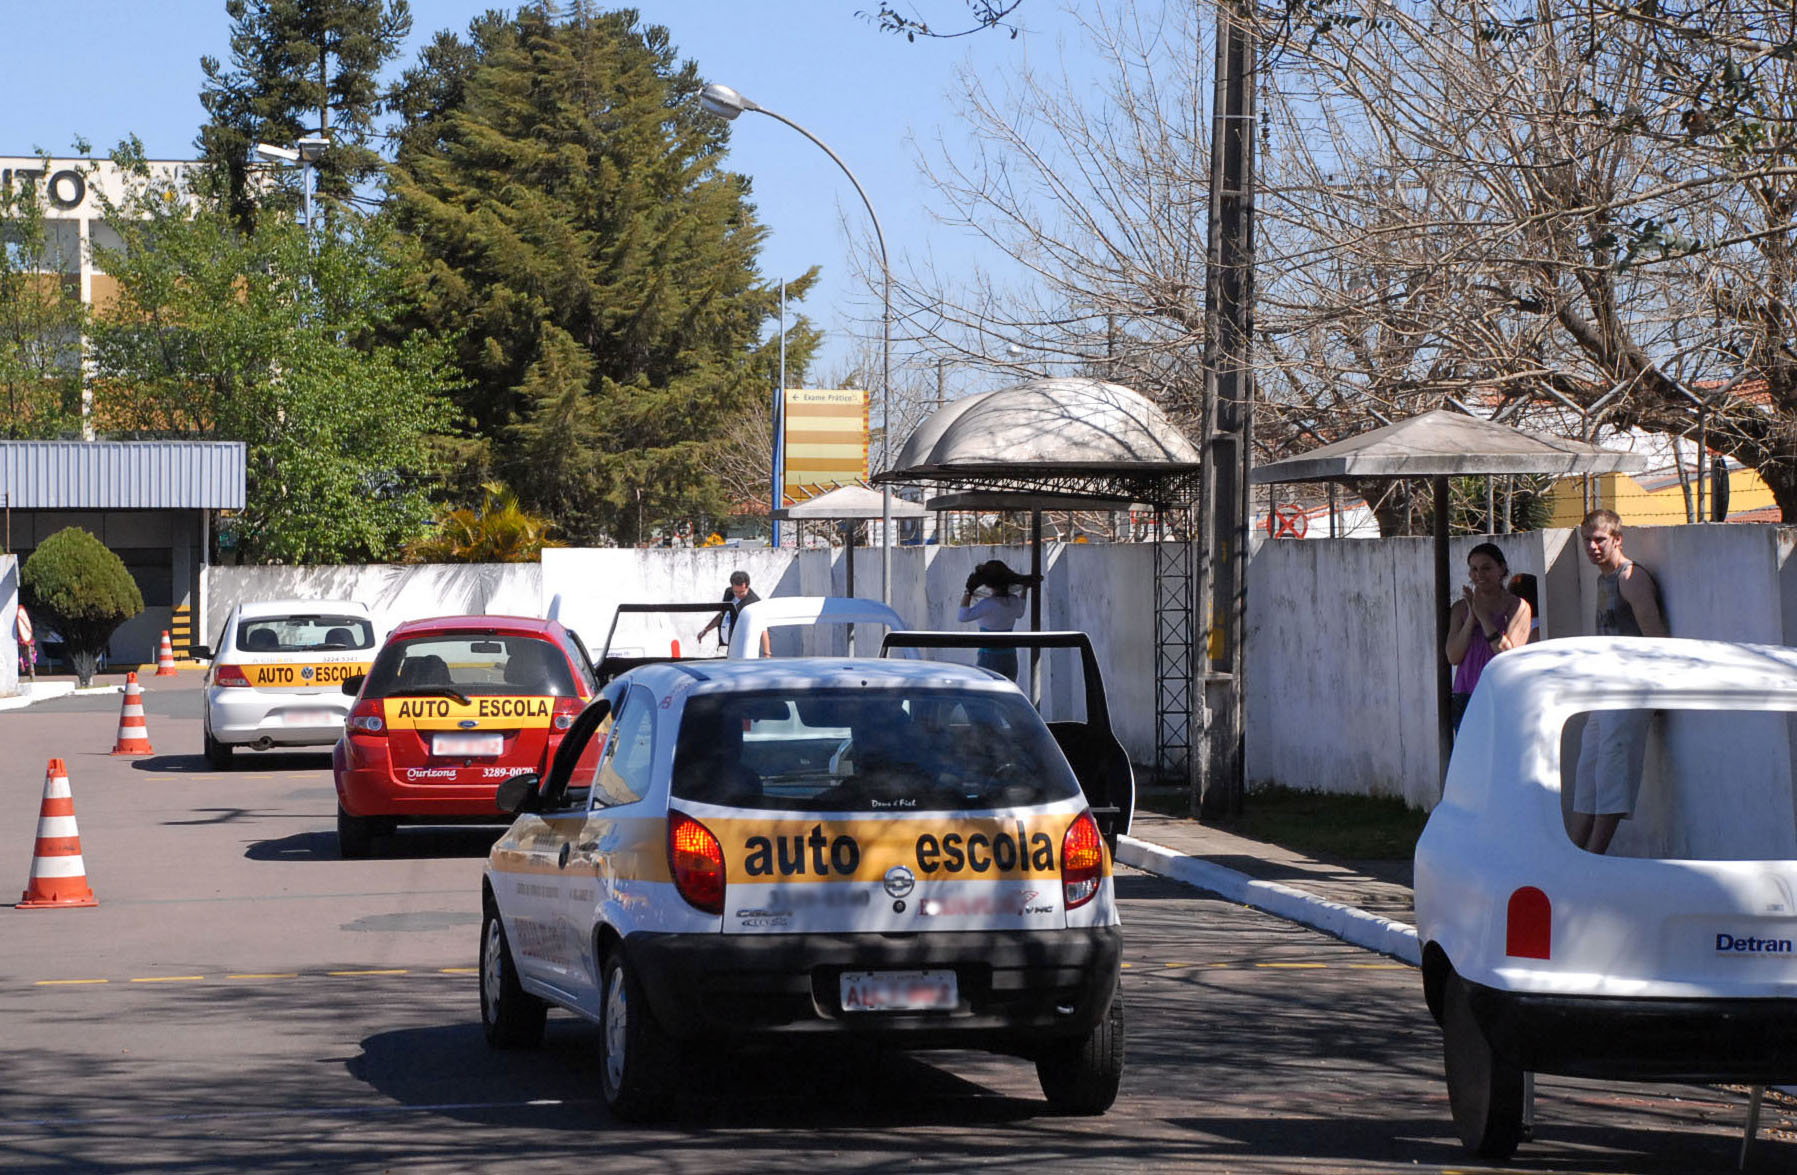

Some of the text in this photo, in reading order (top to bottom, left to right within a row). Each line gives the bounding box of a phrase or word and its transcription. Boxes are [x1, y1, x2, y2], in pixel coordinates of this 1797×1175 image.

[258, 666, 363, 684] AUTO ESCOLA
[398, 699, 549, 719] AUTO ESCOLA
[899, 798, 917, 807] Fiel
[743, 819, 1056, 876] auto escola
[1715, 933, 1793, 952] Detran
